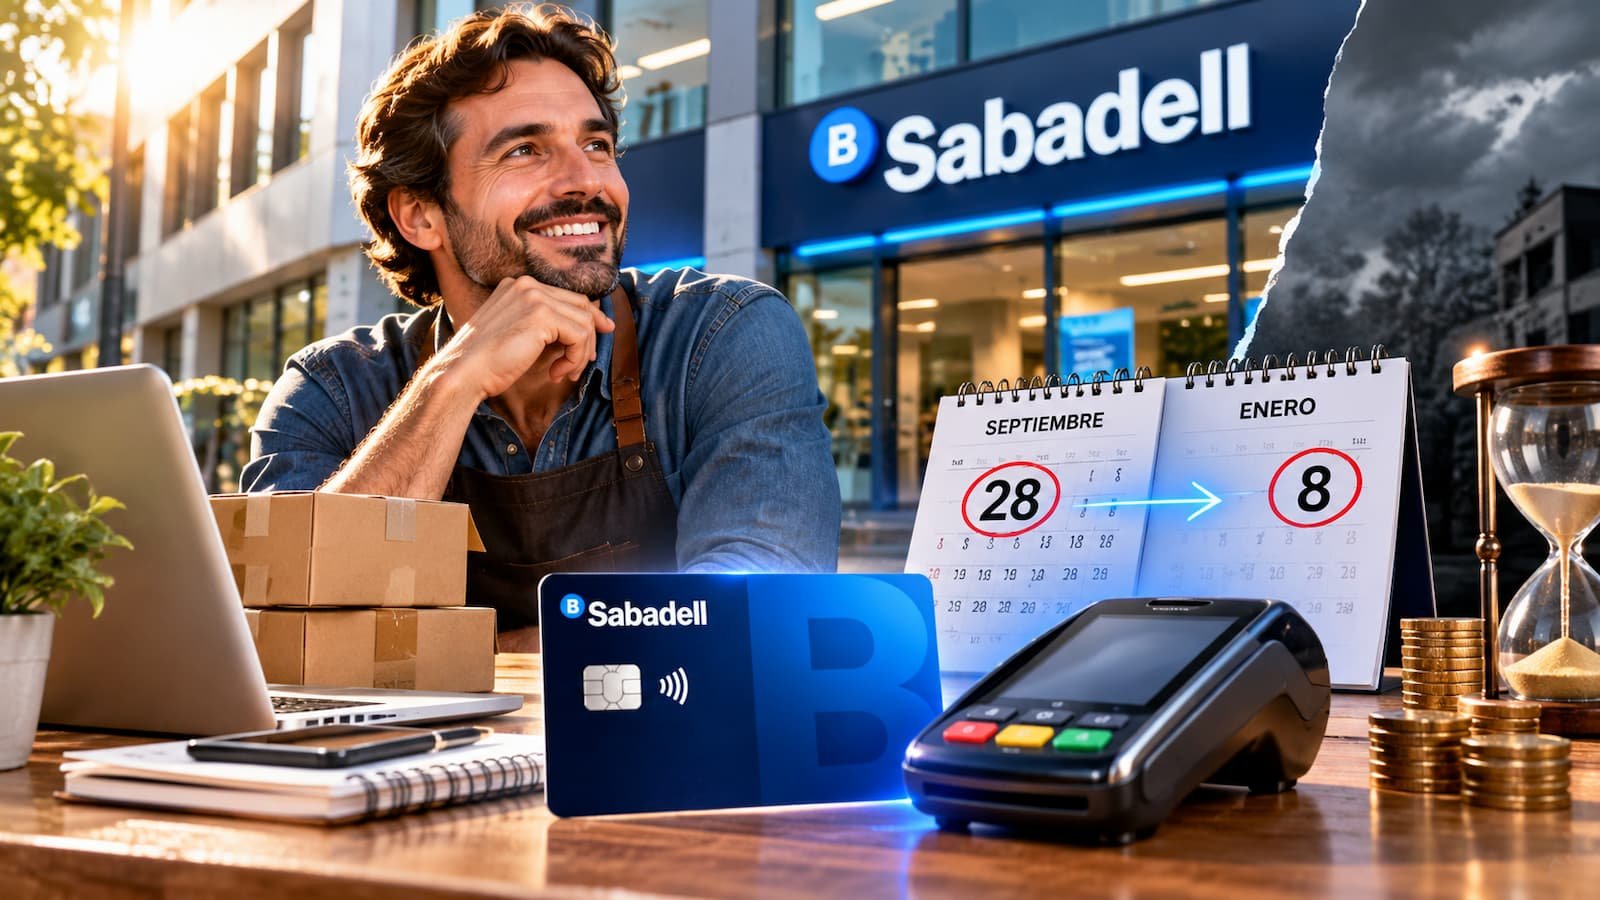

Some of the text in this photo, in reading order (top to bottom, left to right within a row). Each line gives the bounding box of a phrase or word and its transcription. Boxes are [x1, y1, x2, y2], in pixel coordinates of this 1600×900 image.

[828, 42, 1252, 194] B Sabadell
[985, 412, 1105, 436] SEPTIEMBRE
[1240, 397, 1316, 420] ENERO
[979, 478, 1042, 521] 28
[1297, 465, 1332, 513] 8
[566, 598, 708, 628] B Sabadell
